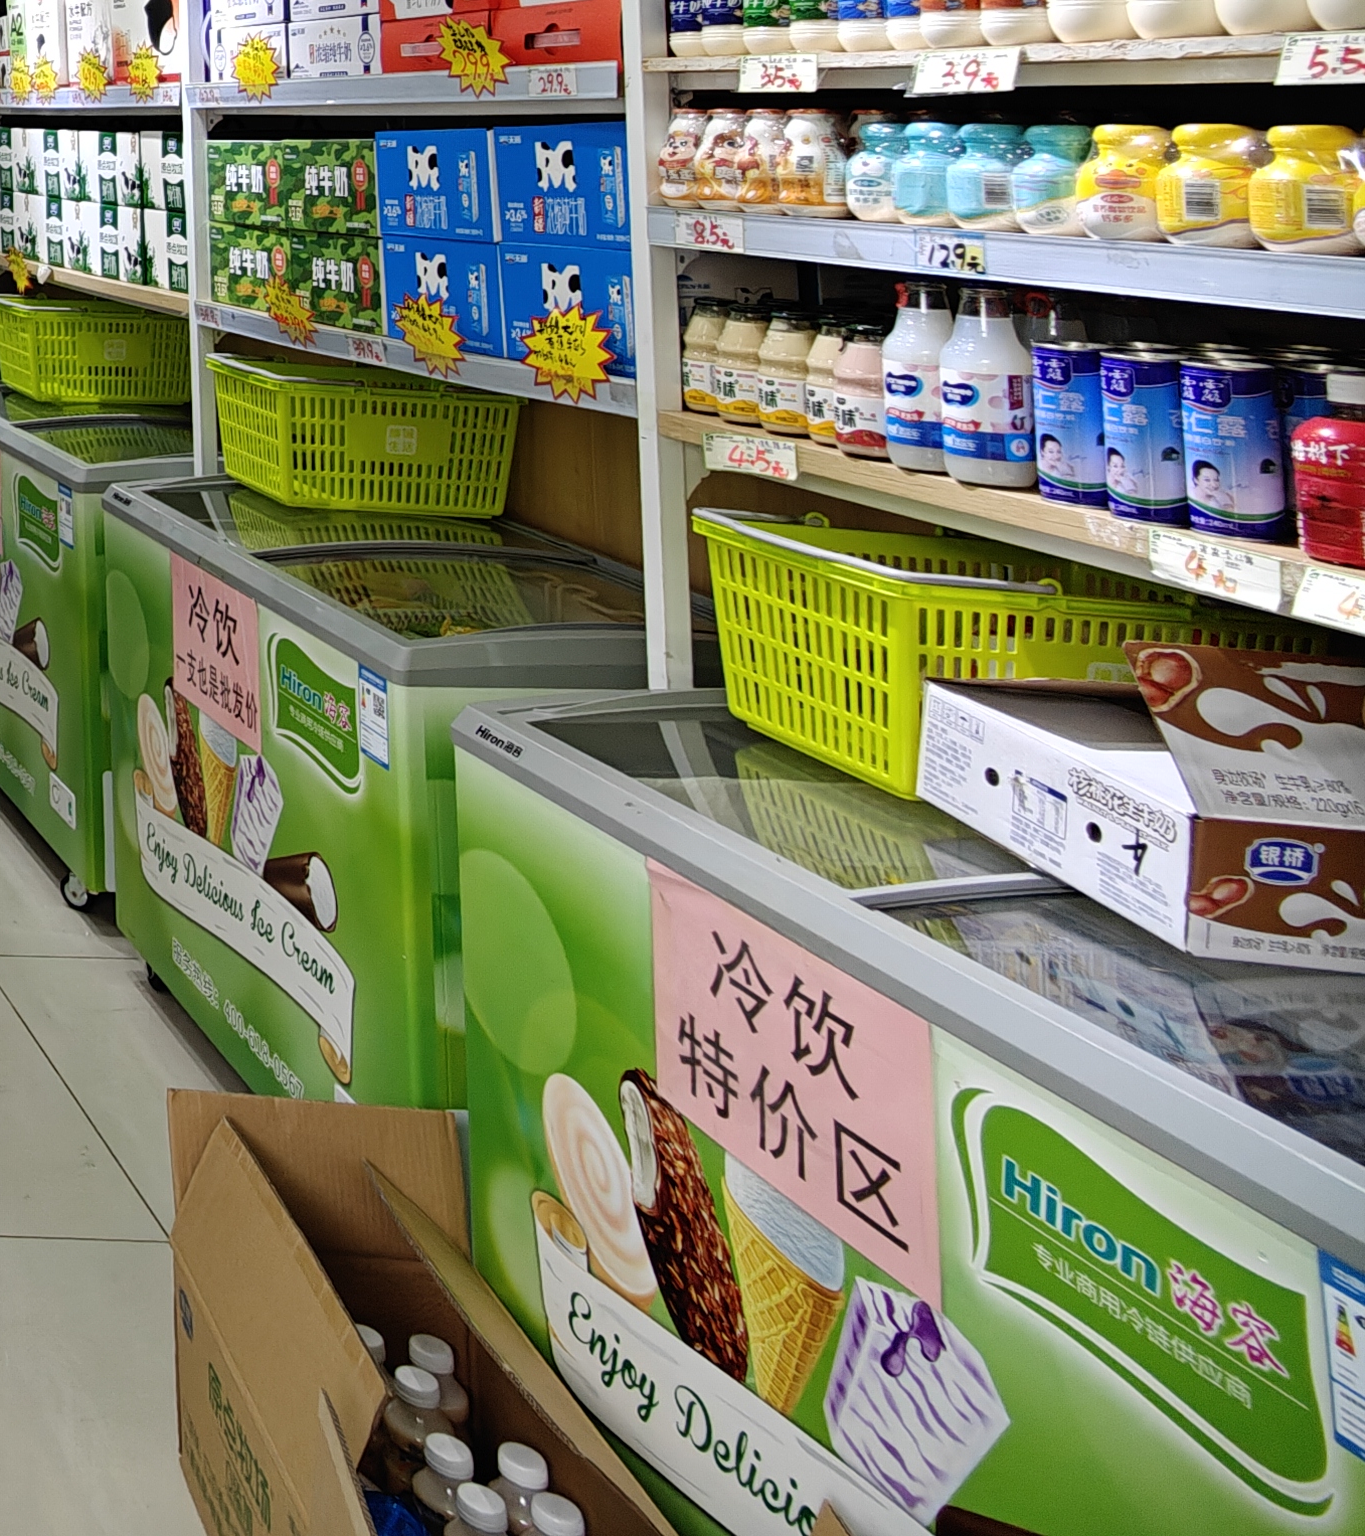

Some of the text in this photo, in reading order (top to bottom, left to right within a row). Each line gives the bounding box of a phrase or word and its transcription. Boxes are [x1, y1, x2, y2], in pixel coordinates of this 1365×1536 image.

[10, 13, 23, 37] A2
[225, 164, 264, 193] 纯牛奶
[304, 165, 349, 199] 纯牛奶
[229, 246, 269, 277] 纯牛奶
[312, 256, 355, 294] 纯牛奶
[187, 582, 241, 668] 冷饮
[21, 674, 51, 715] Cream
[173, 648, 259, 736] 一支也是批发价
[279, 663, 323, 714] Hiron
[474, 724, 505, 750] Hiron
[1067, 767, 1177, 844] 核桃花生牛奶
[1258, 842, 1308, 870] 银桥
[145, 820, 337, 996] Enjoy Delicious Ice Cream
[709, 930, 861, 1101] 冷饮
[677, 1011, 910, 1254] 特价区
[1001, 1154, 1163, 1299] Hiron
[567, 1290, 661, 1421] Enjoy
[1031, 1242, 1253, 1410] 专业商用冷链供应商
